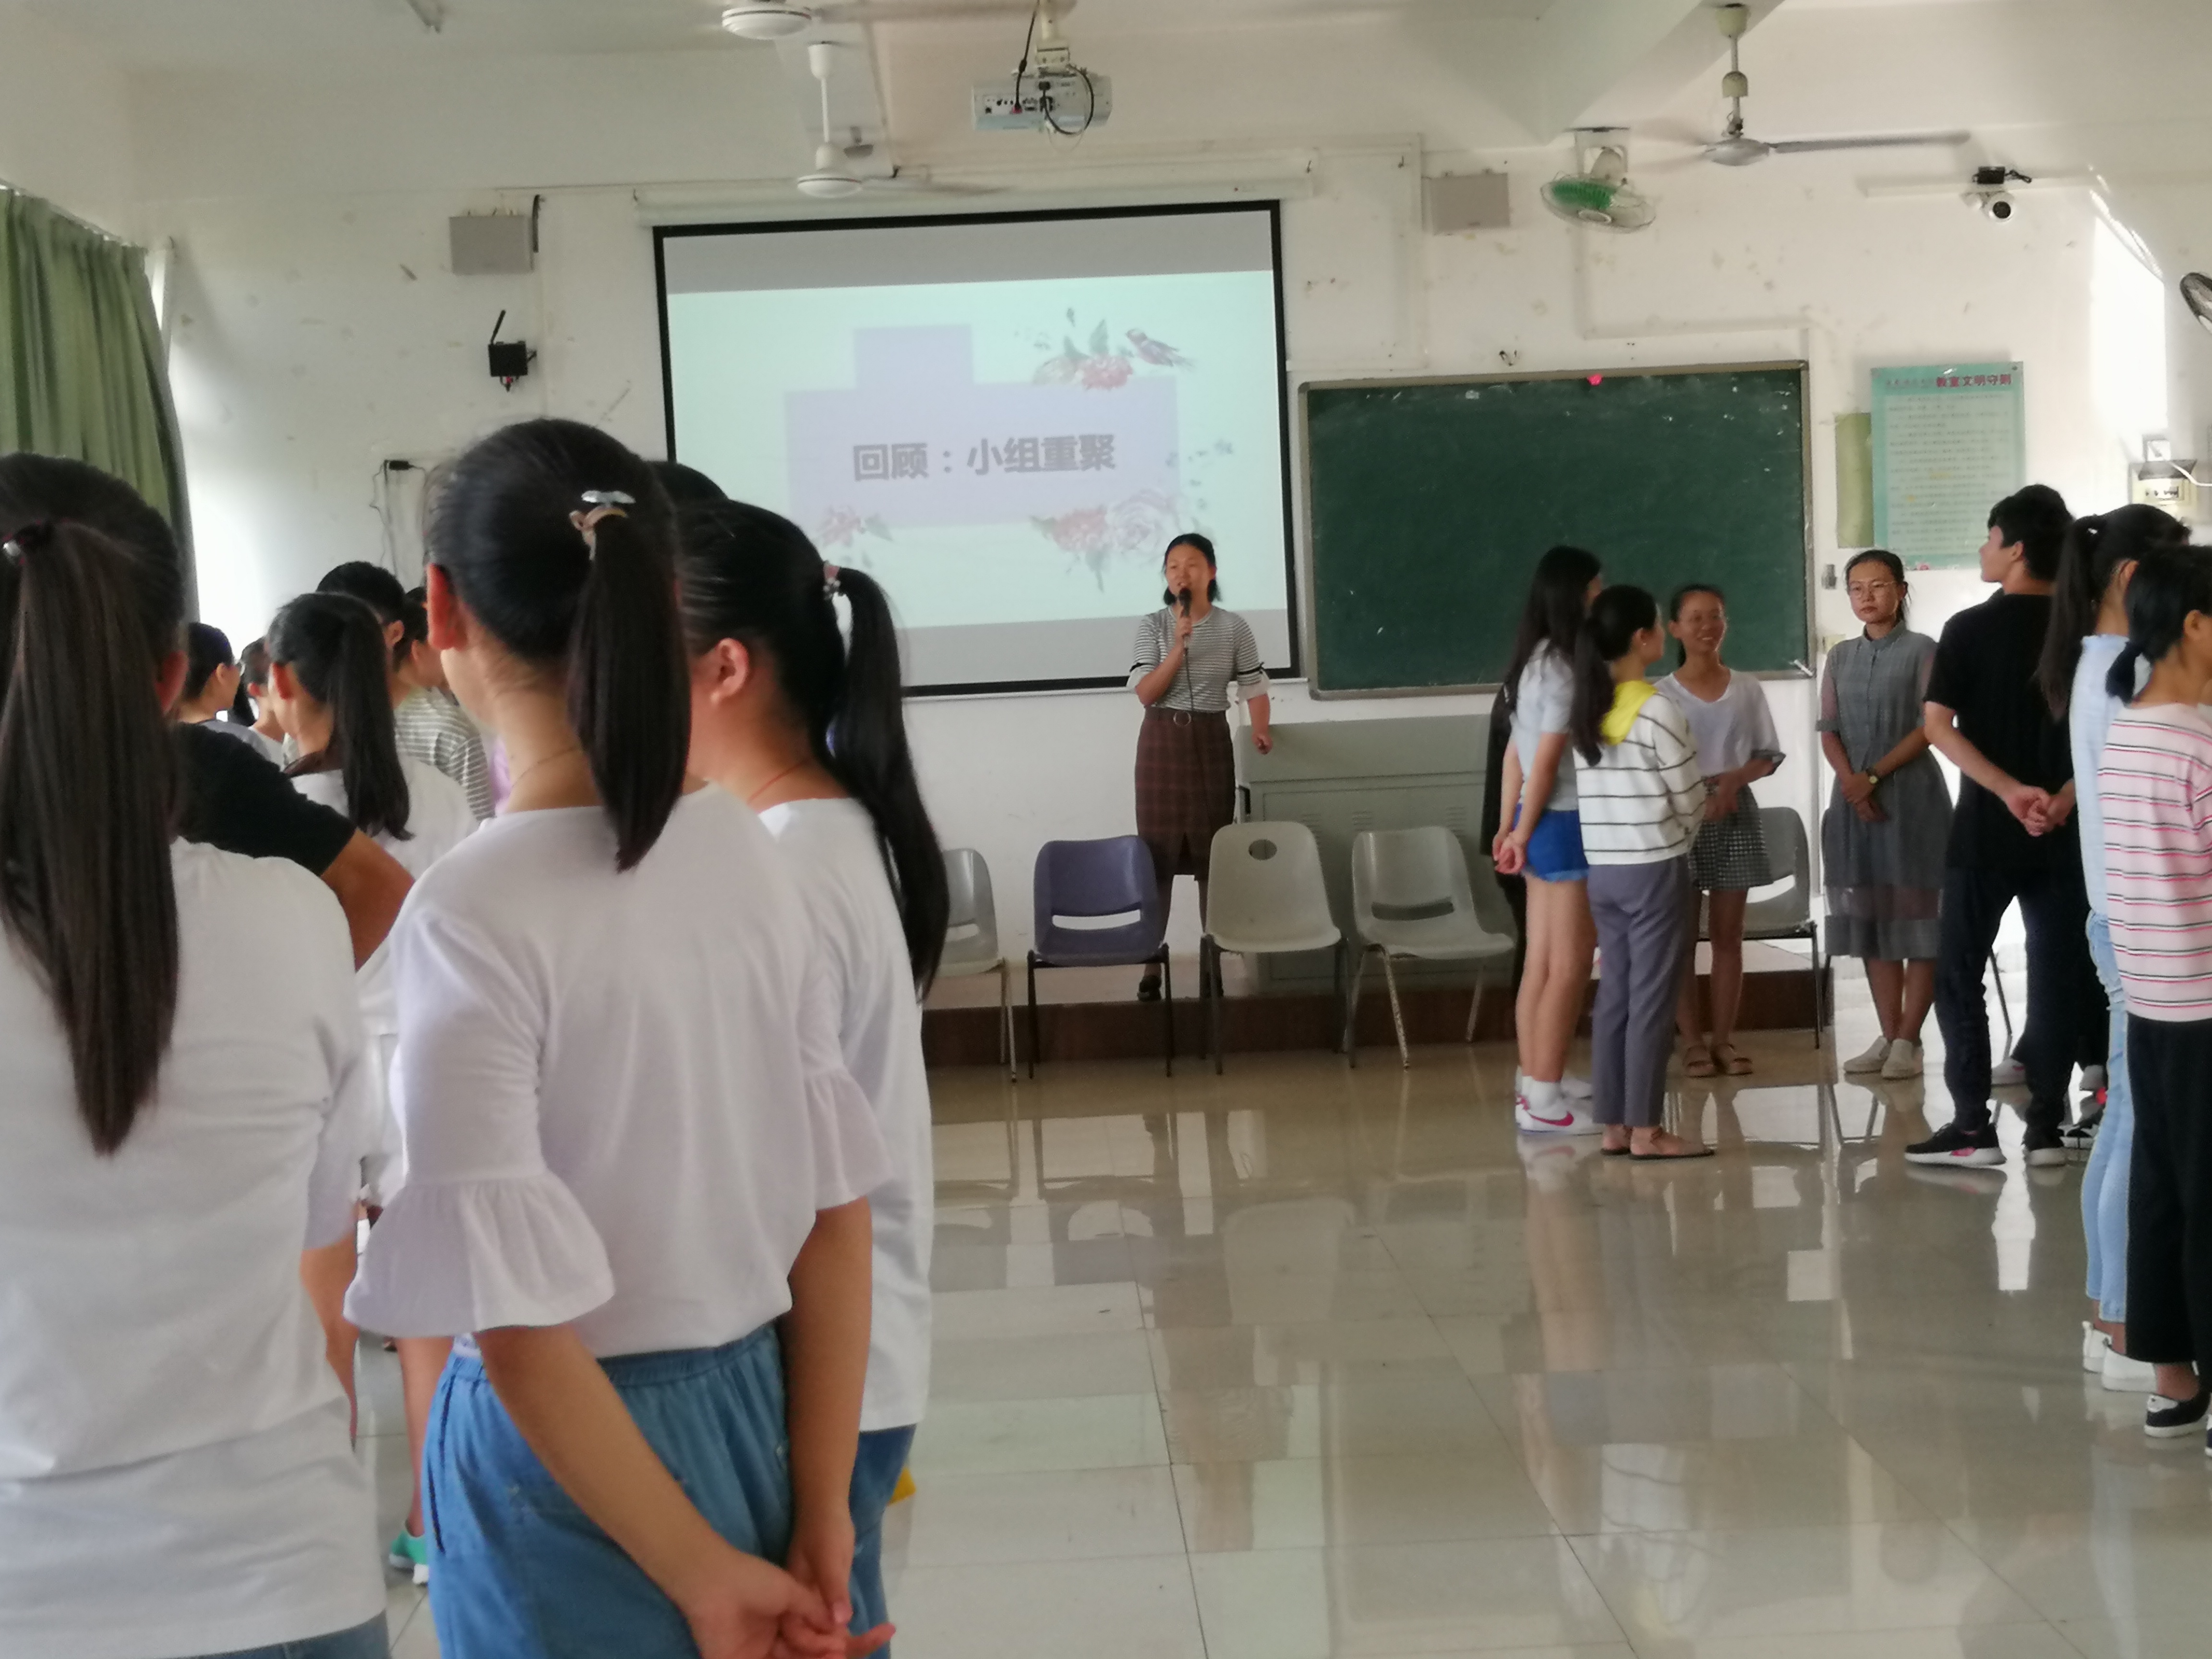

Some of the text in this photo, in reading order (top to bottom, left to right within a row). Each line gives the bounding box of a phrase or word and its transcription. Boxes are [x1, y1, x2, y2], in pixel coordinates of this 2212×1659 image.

[853, 434, 1115, 481] 回顾：小组重聚
